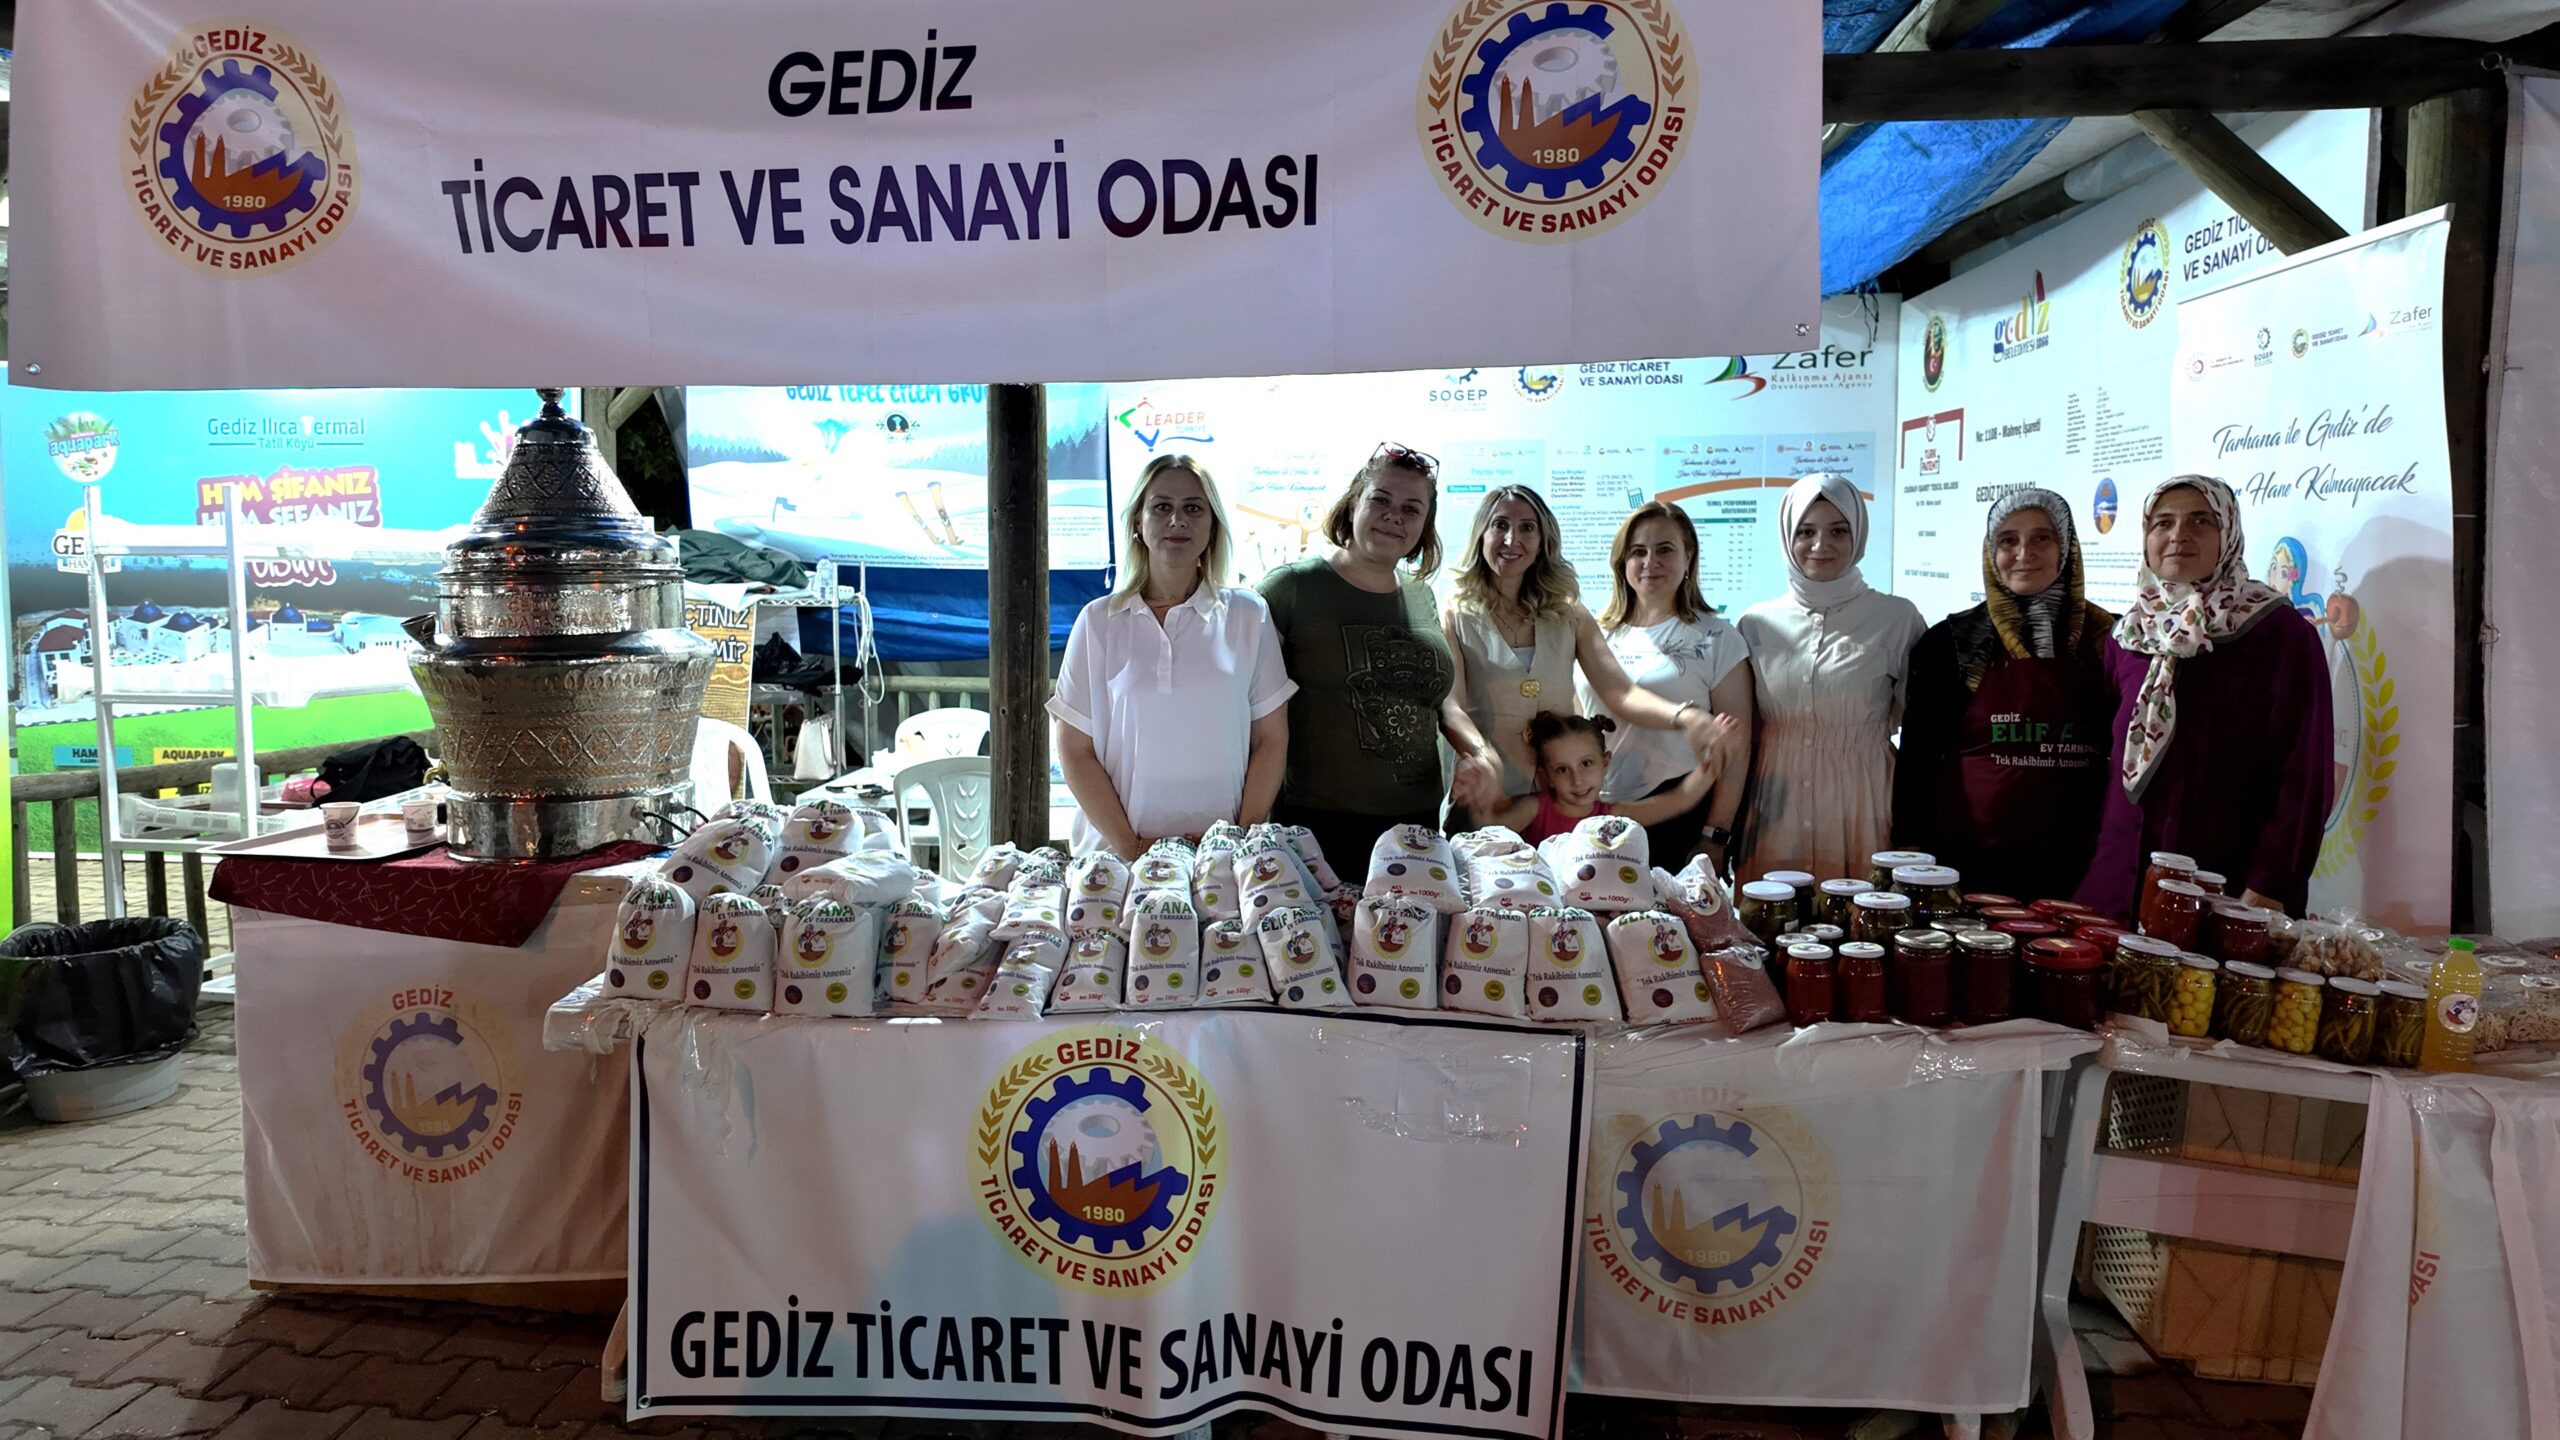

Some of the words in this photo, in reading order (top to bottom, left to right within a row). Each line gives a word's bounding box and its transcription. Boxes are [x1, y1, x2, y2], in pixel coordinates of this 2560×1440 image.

[192, 25, 267, 58] GEDİZ
[768, 28, 977, 117] GEDİZ
[1532, 148, 1580, 165] 1980
[1428, 118, 1500, 217] TİCARET
[1502, 206, 1536, 232] VE
[1541, 179, 1640, 233] SANAYİ
[1636, 106, 1686, 186] ODASI
[222, 195, 267, 209] 1980
[441, 158, 701, 254] TİCARET
[719, 168, 805, 245] VE
[828, 138, 1070, 245] SANAYİ
[1097, 154, 1318, 238] ODASI
[132, 164, 194, 253] TİCARET
[196, 243, 225, 268] VE
[229, 227, 317, 270] SANAYİ
[316, 163, 353, 235] ODASI
[2184, 219, 2223, 254] GEDİZ
[2183, 260, 2200, 282] VE
[2203, 234, 2252, 275] SANAYİ
[2390, 306, 2433, 326] Zafer
[1618, 360, 1671, 373] TİCARET
[1772, 345, 1874, 370] Zafer
[1579, 376, 1596, 386] VE
[1598, 373, 1642, 386] SANAYİ
[1645, 374, 1683, 385] ODASI
[1428, 389, 1488, 402] SOGEP
[208, 418, 256, 436] Gediz
[1145, 411, 1206, 427] LEADER
[48, 429, 120, 458] aquapark
[259, 438, 283, 449] Tatil
[2212, 424, 2282, 459] Tarhana
[2285, 417, 2301, 445] ile
[201, 481, 263, 506] HM
[2245, 471, 2292, 508] Hane
[2295, 461, 2420, 508] Kalmayacak
[1990, 712, 2021, 723] GEDİZ
[1991, 718, 2049, 743] ELİF
[72, 748, 98, 758] HAM
[162, 750, 225, 760] AQUAPARK
[2040, 744, 2053, 753] EV
[2012, 755, 2056, 767] Rakibimiz
[818, 905, 855, 917] ANA
[1161, 902, 1192, 914] ANA
[1261, 913, 1288, 932] ELİF
[789, 967, 821, 980] Rakibimiz
[1365, 960, 1397, 972] Rakibimiz
[1453, 960, 1482, 972] Rakibimiz
[1543, 971, 1577, 981] Rakibimiz
[1654, 972, 1686, 984] Rakibimiz
[392, 984, 454, 1011] GEDİZ
[1056, 1033, 1142, 1065] GEDİZ
[343, 1098, 400, 1170] TİCARET
[402, 1162, 424, 1182] VE
[428, 1144, 494, 1184] SANAYİ
[492, 1092, 523, 1151] ODASI
[1081, 1205, 1125, 1224] 1980
[980, 1174, 1054, 1265] TİCARET
[1056, 1256, 1087, 1282] VE
[1092, 1248, 1179, 1289] SANAYİ
[1175, 1173, 1217, 1254] ODASI
[1684, 1249, 1730, 1264] 1980
[1584, 1213, 1655, 1303] TİCARET
[1657, 1295, 1689, 1320] VE
[1693, 1282, 1787, 1325] SANAYİ
[1783, 1220, 1830, 1292] ODASI
[670, 1294, 834, 1379] GEDİZ
[847, 1299, 1070, 1385] TİCARET
[1082, 1319, 1143, 1400] VE
[1160, 1311, 1344, 1400] SANAYİ
[1360, 1336, 1534, 1418] ODASI
